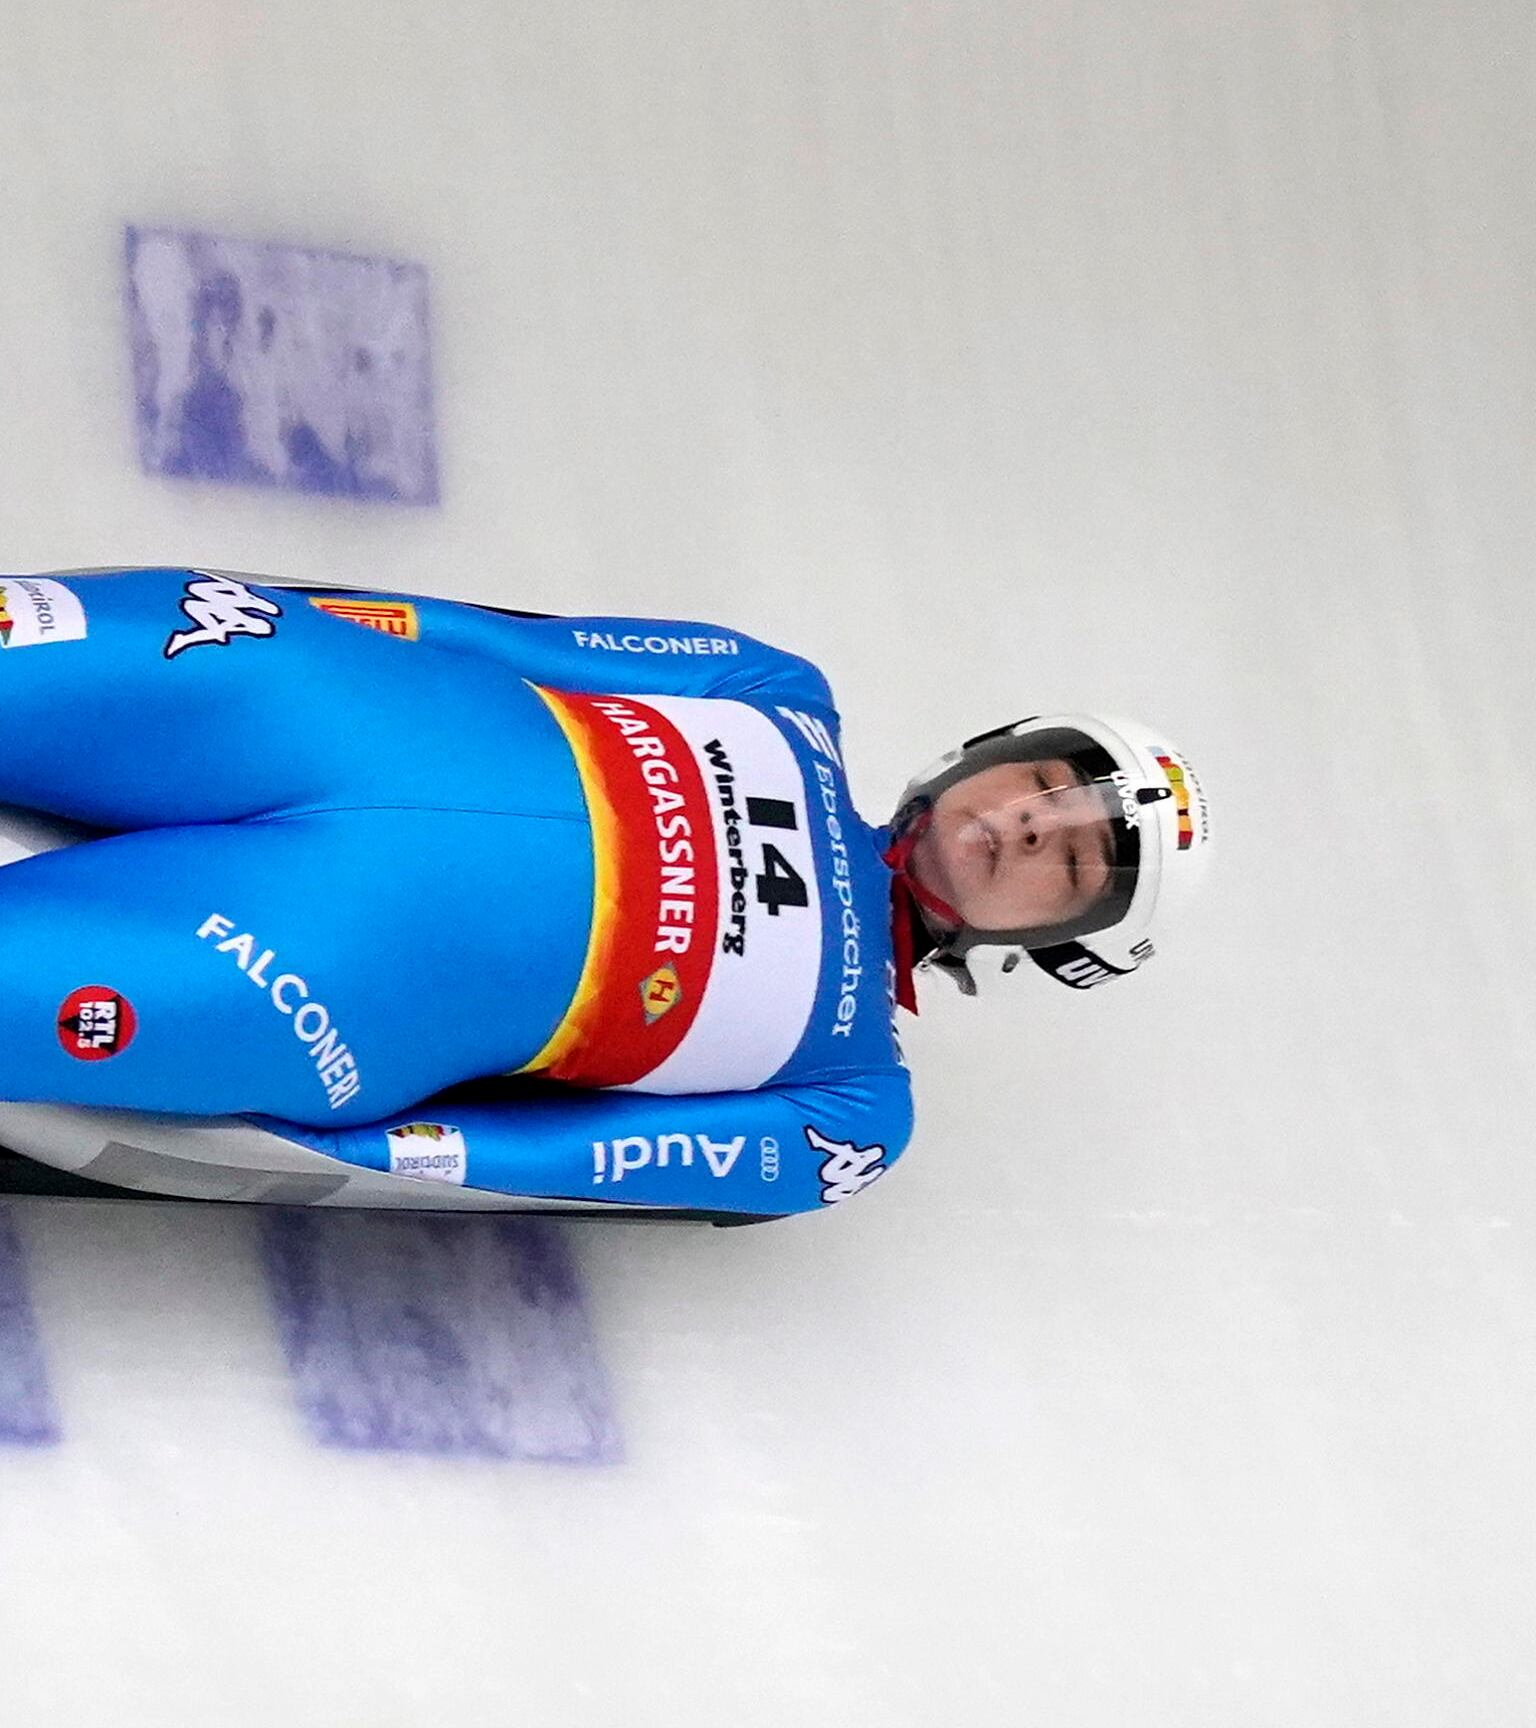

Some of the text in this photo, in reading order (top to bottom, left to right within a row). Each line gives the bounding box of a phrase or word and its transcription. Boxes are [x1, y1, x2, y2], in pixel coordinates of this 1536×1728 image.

[572, 630, 739, 655] FALCONERI
[591, 700, 696, 955] HARGASSNER
[703, 738, 749, 957] Winterberg
[745, 796, 809, 917] 14
[813, 757, 863, 1038] Eberspächer
[92, 1001, 117, 1049] RTL
[195, 912, 361, 1111] FALCONERI
[592, 1133, 747, 1185] Audi
